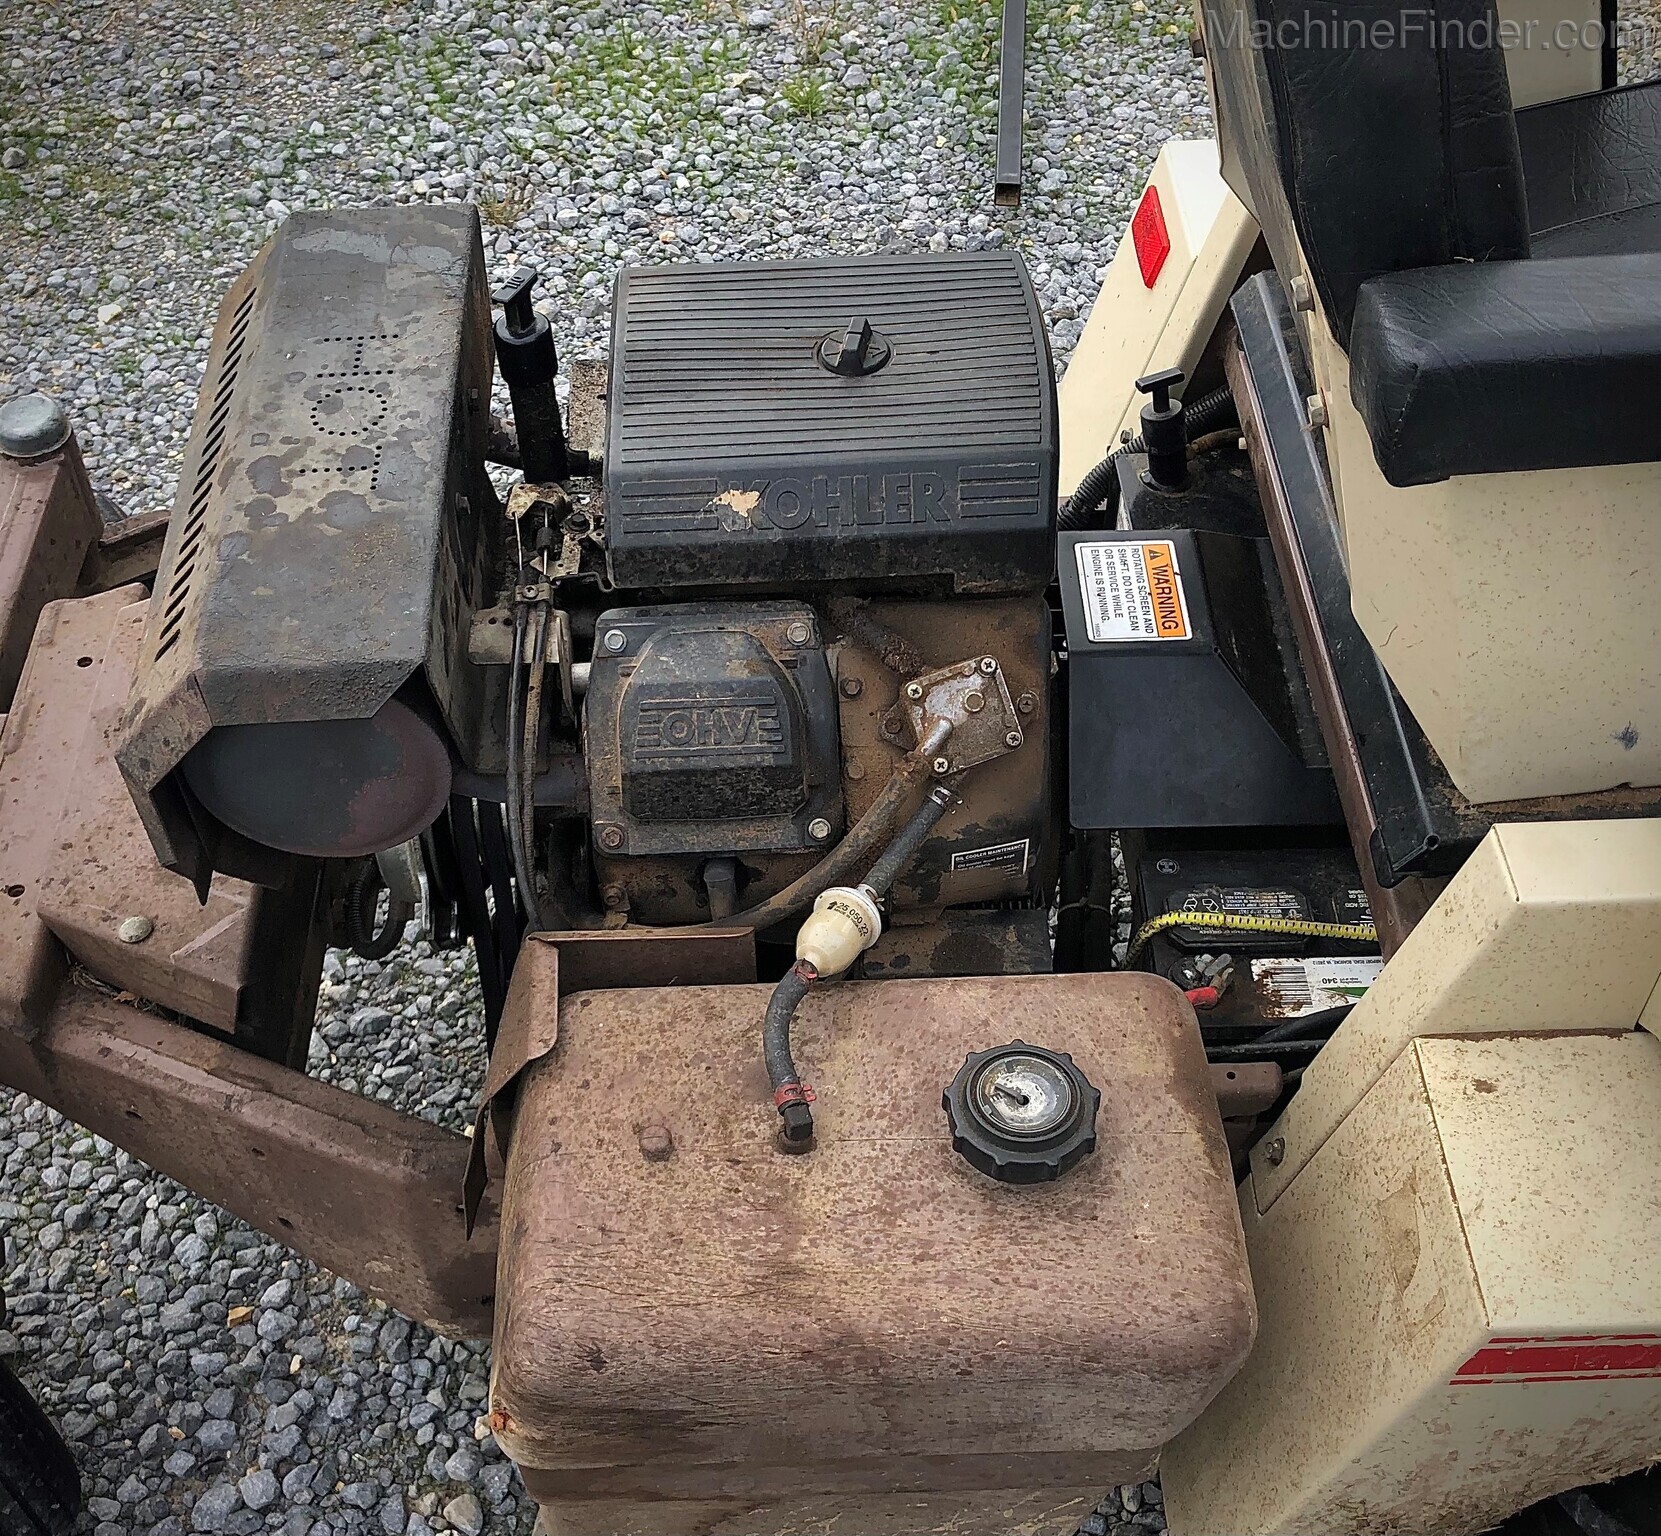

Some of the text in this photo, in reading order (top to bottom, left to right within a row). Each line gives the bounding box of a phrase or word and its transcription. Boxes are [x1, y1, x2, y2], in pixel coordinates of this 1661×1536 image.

[727, 472, 952, 530] KOHLER
[1091, 549, 1103, 576] ENGINE
[1095, 577, 1104, 585] IS
[1104, 548, 1124, 618] OR SERVICE WHILE
[1118, 548, 1140, 631] SHAFT. DO NOT CLEAN
[1131, 547, 1154, 634] ROTATING SCREEN AND
[1152, 563, 1179, 630] WARNING
[1097, 586, 1110, 623] RUNNING.
[662, 706, 758, 745] OHV
[965, 851, 987, 860] COOLER
[987, 844, 1024, 855] MAINTENANCE
[837, 902, 849, 911] 25
[849, 909, 864, 924] 050
